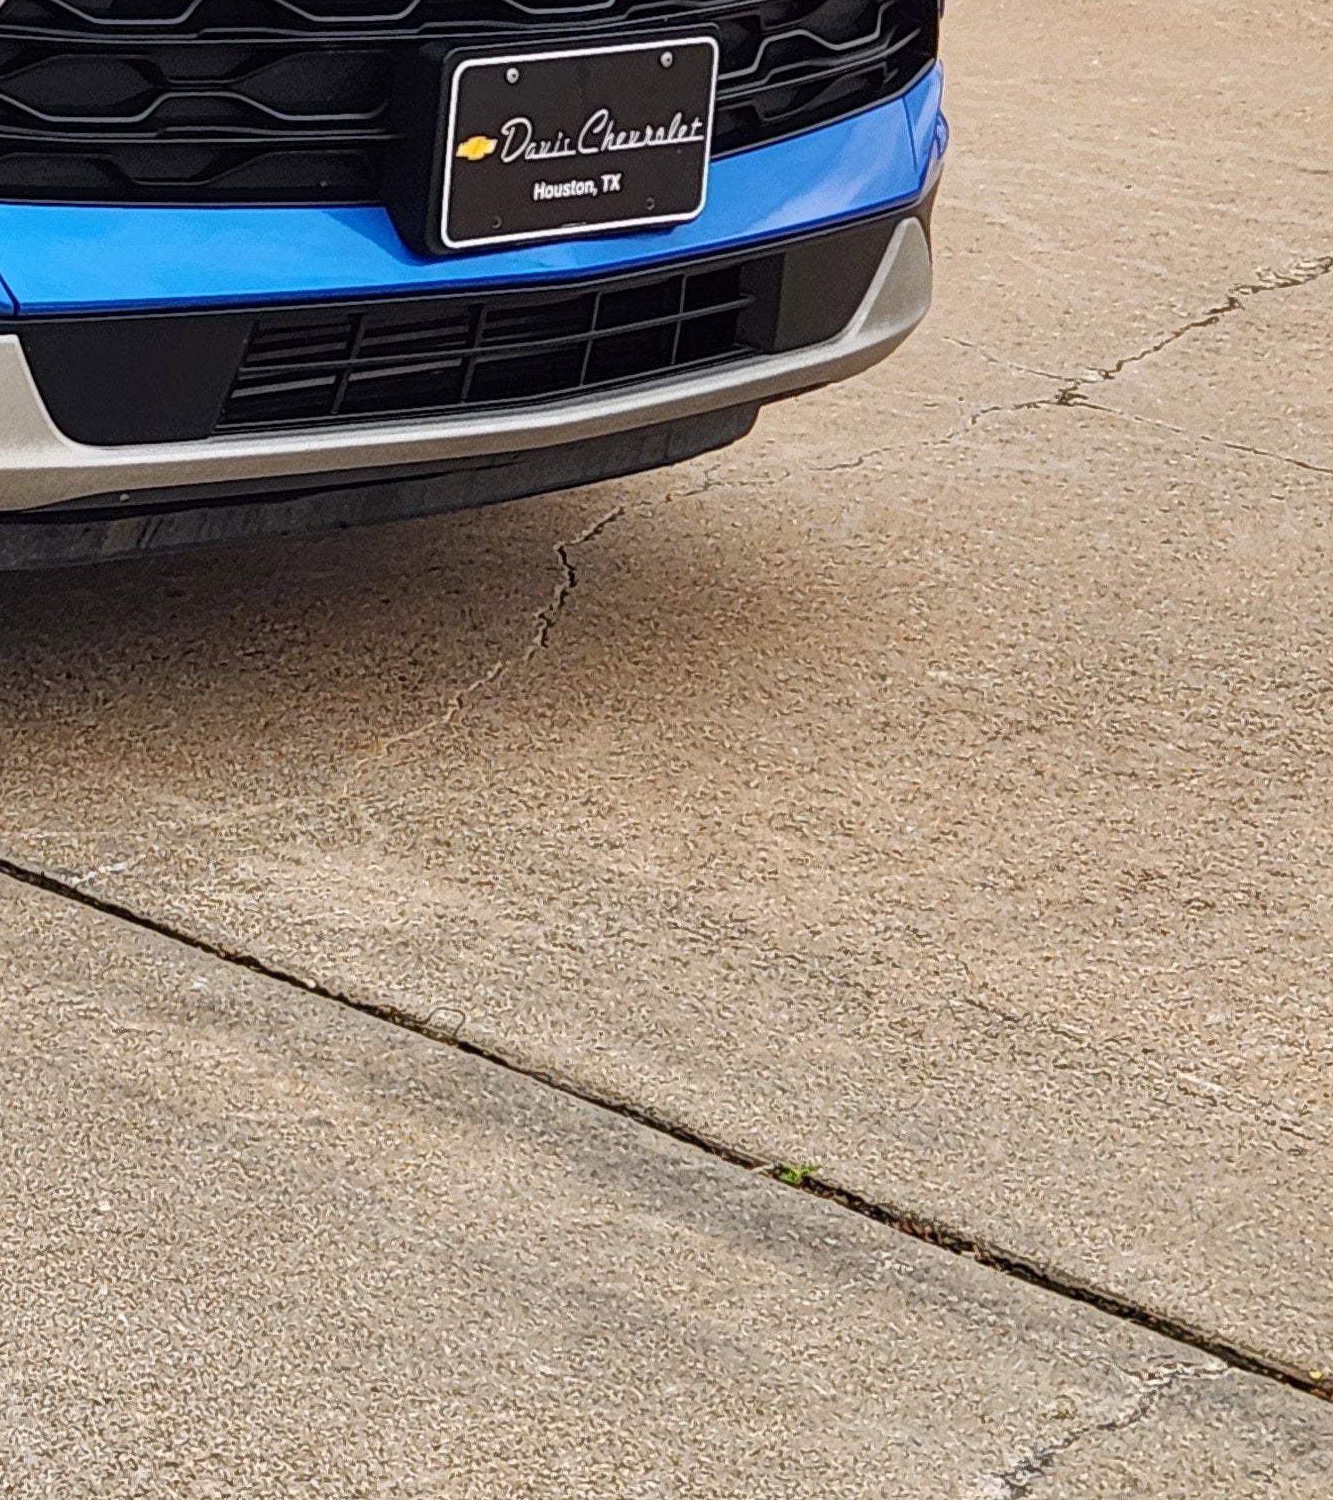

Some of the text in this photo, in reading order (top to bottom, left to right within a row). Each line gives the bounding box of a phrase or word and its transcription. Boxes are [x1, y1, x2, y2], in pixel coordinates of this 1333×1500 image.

[500, 108, 705, 163] Davis Chevrolet
[533, 173, 623, 201] Houston, TX
